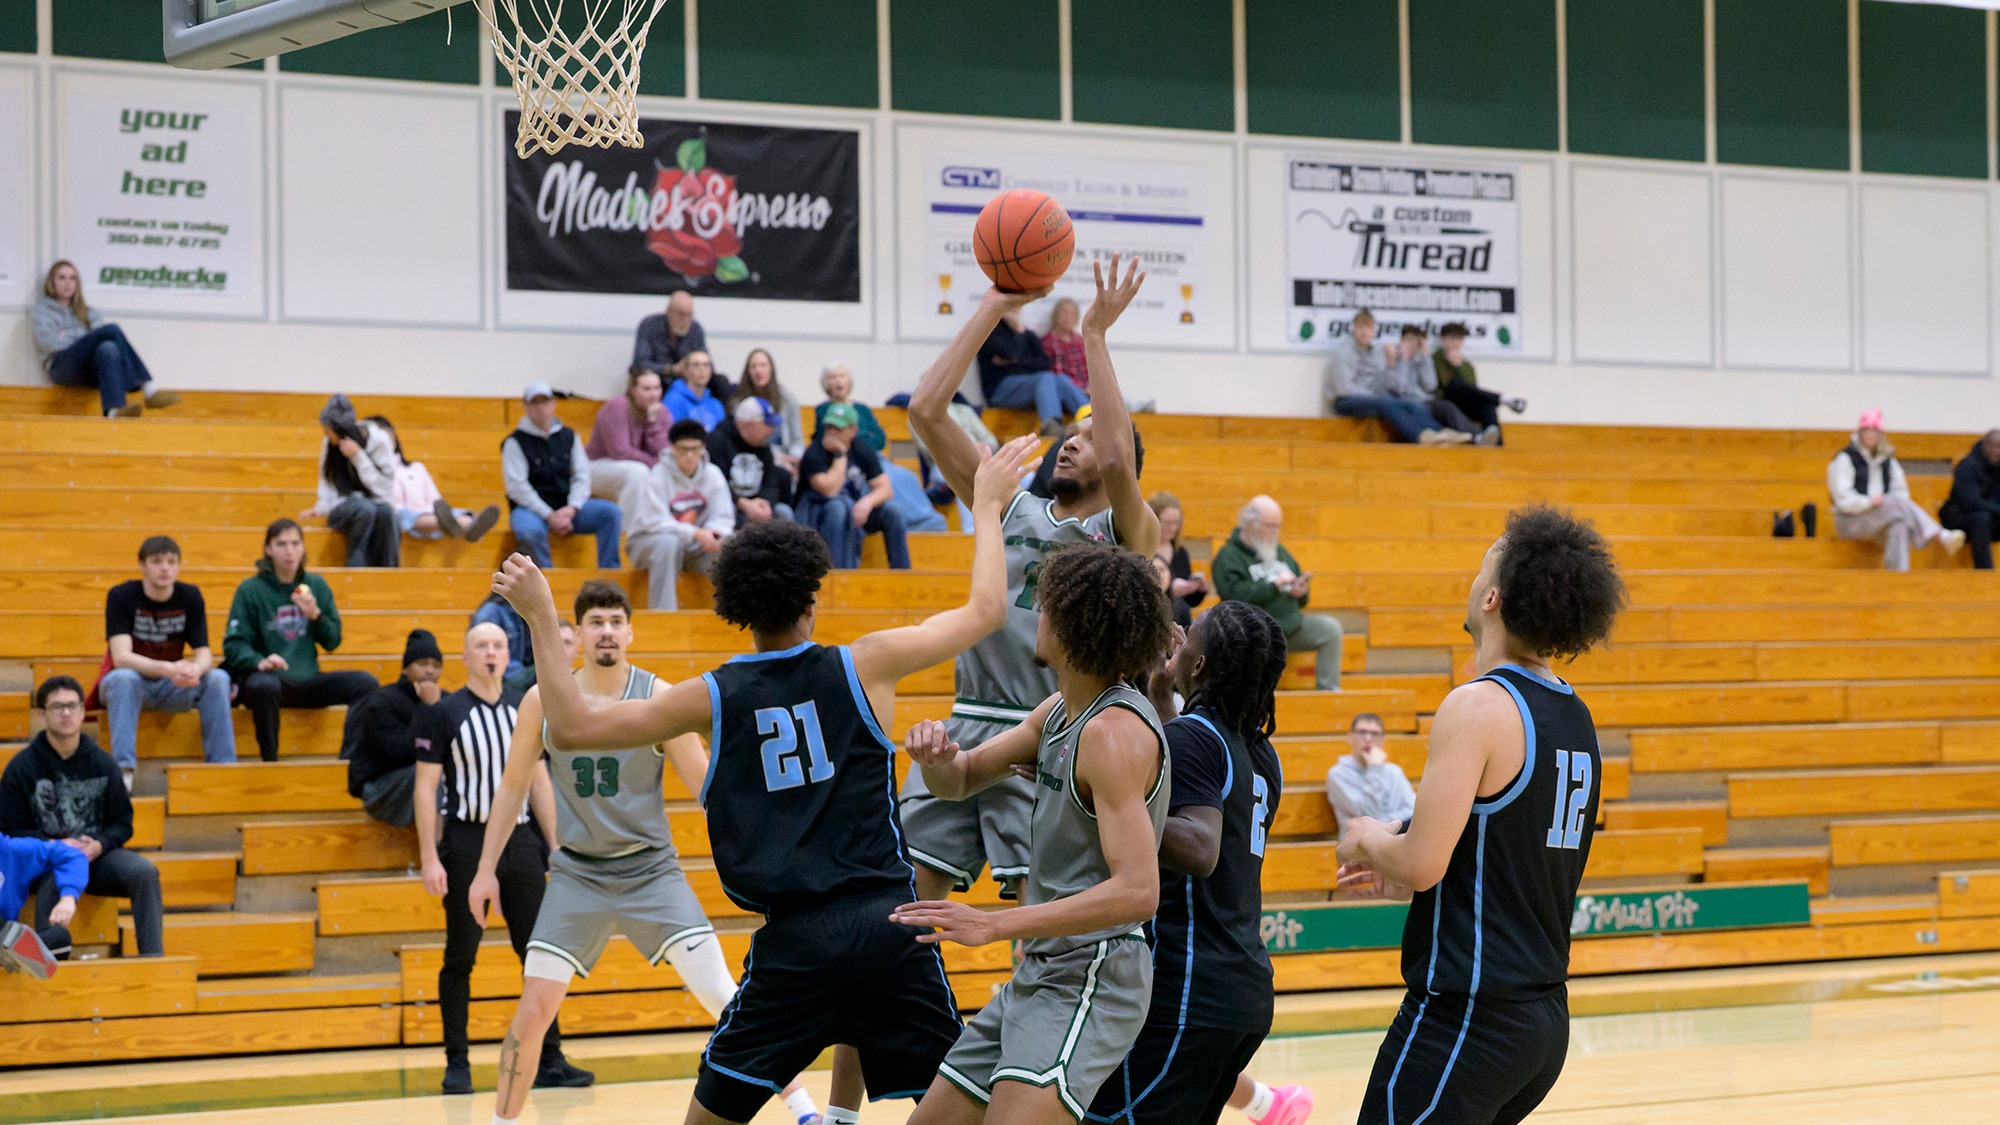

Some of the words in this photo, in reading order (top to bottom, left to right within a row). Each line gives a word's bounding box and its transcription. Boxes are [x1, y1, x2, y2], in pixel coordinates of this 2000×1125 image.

[119, 108, 208, 133] your
[141, 139, 187, 163] ad
[121, 170, 207, 198] here
[942, 166, 1000, 188] CTM
[536, 159, 690, 238] Madres
[691, 173, 833, 238] Espresso
[1394, 206, 1472, 223] custom
[98, 218, 156, 229] contact
[183, 221, 229, 235] today
[1358, 225, 1492, 272] Thread
[99, 265, 227, 285] geoducks
[754, 699, 835, 792] 21
[572, 756, 620, 798] 33
[1250, 770, 1269, 858] 2
[1545, 748, 1593, 850] 12
[1594, 897, 1654, 931] Mud
[1654, 891, 1700, 929] Pit
